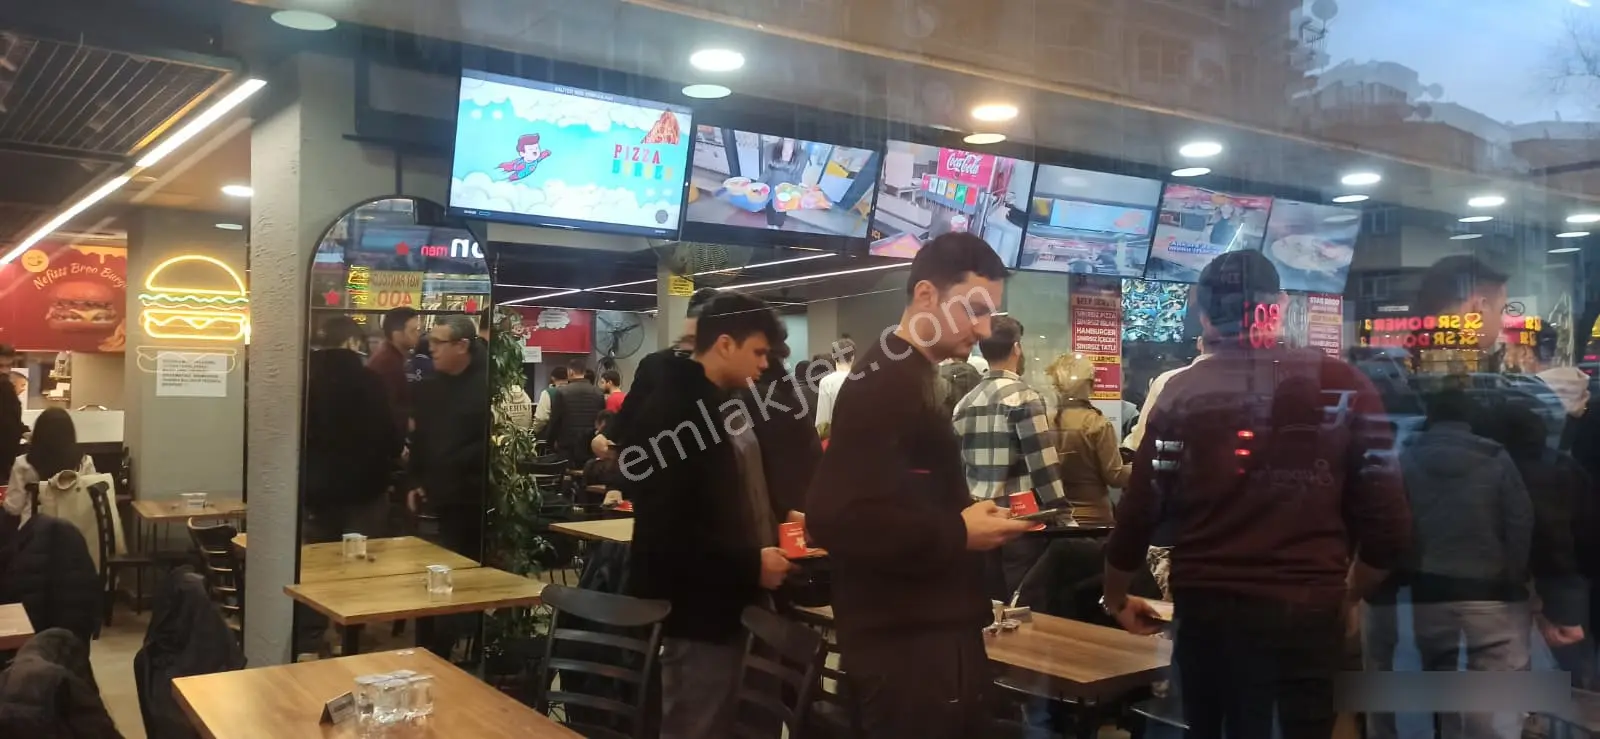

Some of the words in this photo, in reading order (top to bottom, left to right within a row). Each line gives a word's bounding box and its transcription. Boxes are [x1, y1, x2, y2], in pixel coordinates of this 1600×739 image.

[613, 144, 661, 165] PIZZA
[100, 267, 129, 289] Burg
[1076, 327, 1117, 336] HAMBURGER
